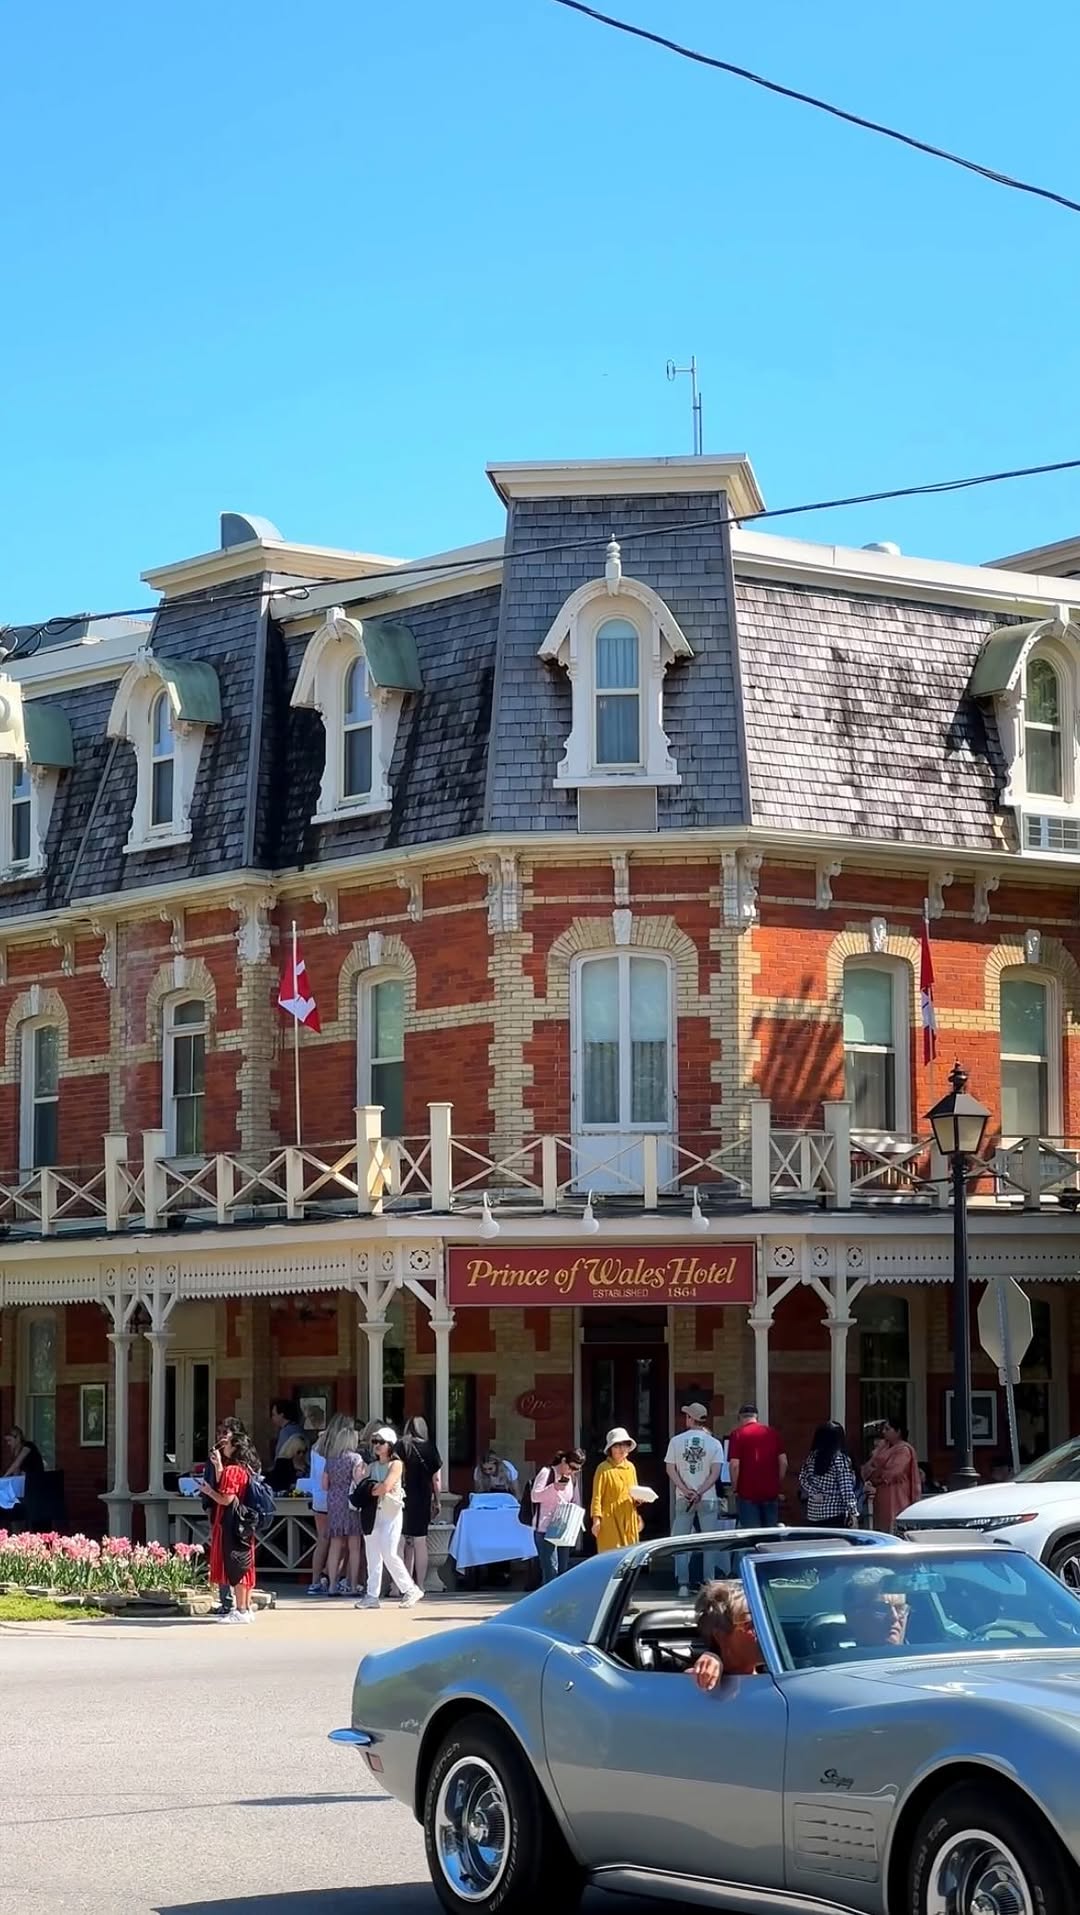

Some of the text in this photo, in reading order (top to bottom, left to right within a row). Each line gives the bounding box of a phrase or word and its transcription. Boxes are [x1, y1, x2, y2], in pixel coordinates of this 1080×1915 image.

[467, 1257, 738, 1294] Prince of Wales Hotel
[593, 1287, 697, 1298] ESTABLISHED 1864
